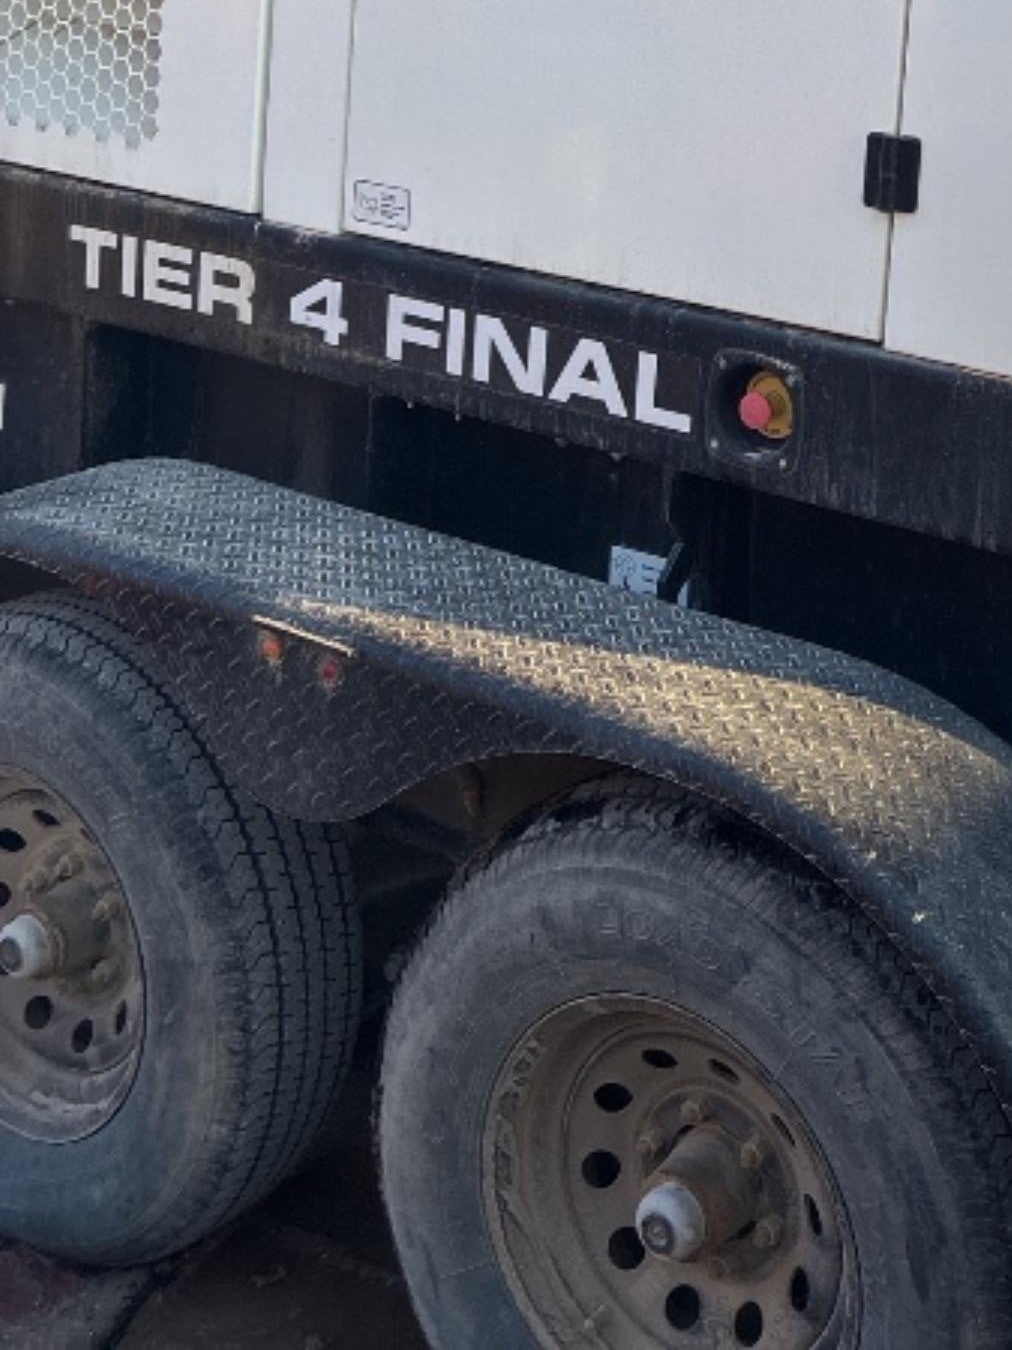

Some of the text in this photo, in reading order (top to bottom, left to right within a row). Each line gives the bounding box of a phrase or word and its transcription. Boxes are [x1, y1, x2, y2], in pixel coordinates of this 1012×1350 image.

[69, 224, 692, 433] TIER 4 FINAL
